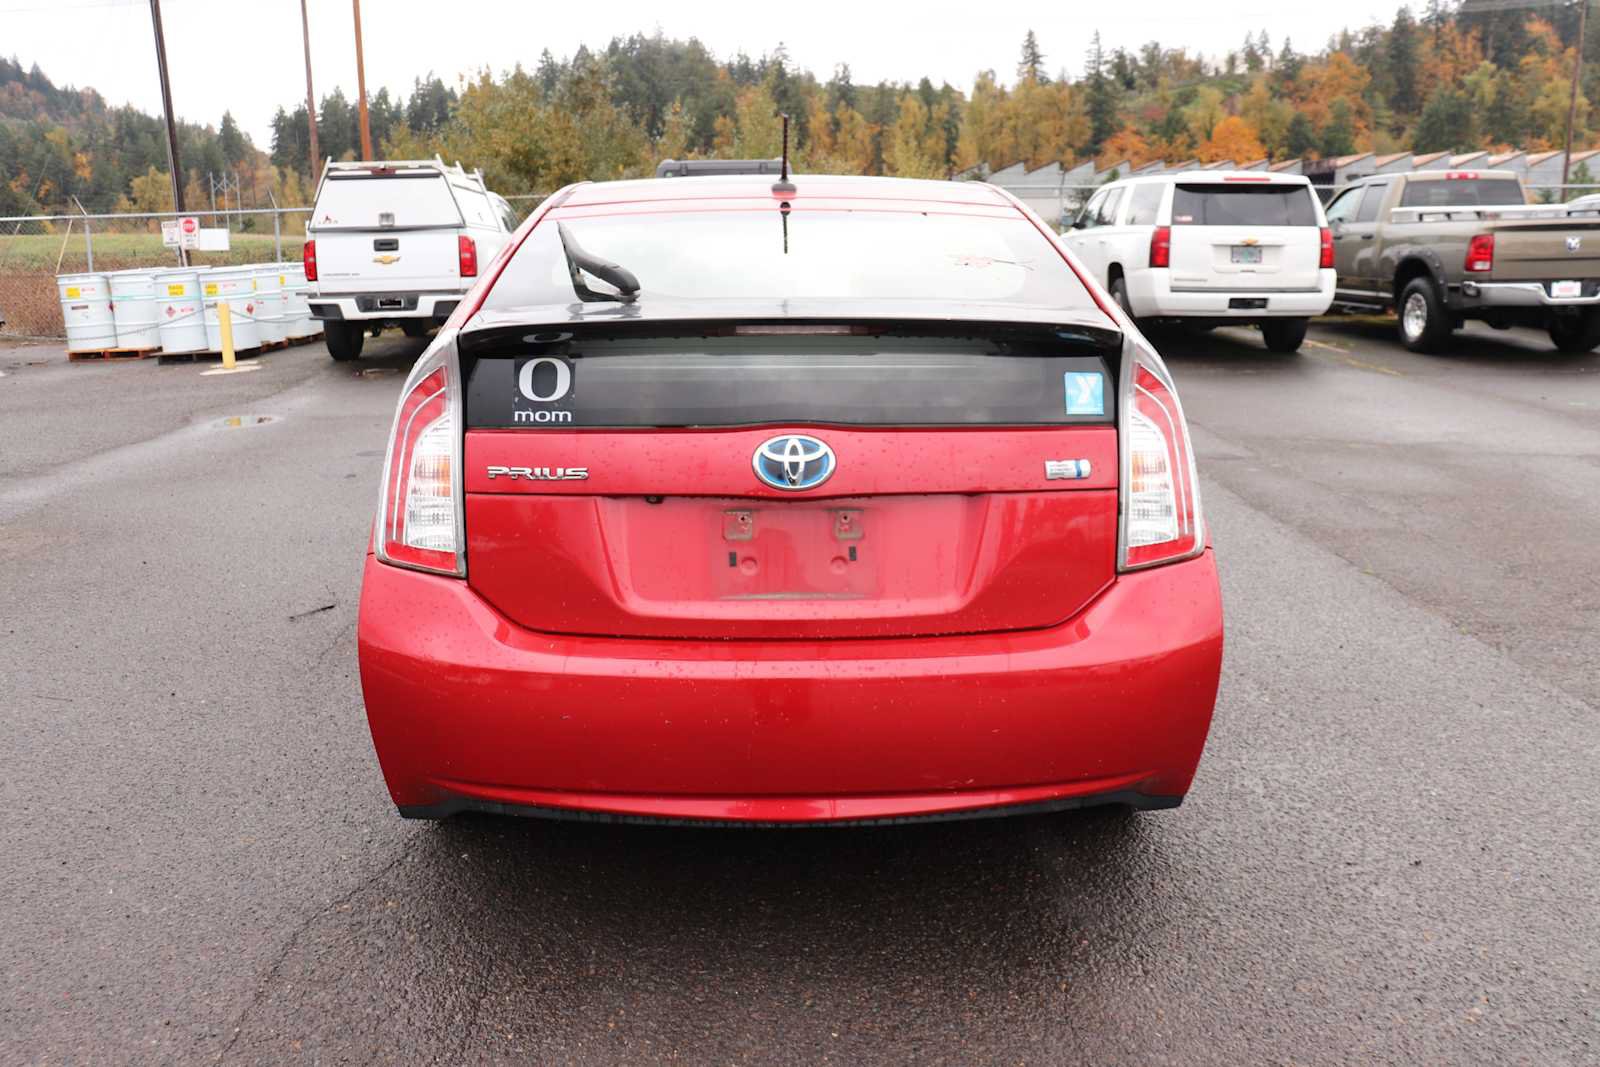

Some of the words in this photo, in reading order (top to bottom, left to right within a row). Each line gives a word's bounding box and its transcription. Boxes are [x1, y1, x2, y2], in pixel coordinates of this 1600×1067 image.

[518, 357, 571, 402] O
[514, 410, 572, 422] mom
[487, 466, 589, 480] PRIUS
